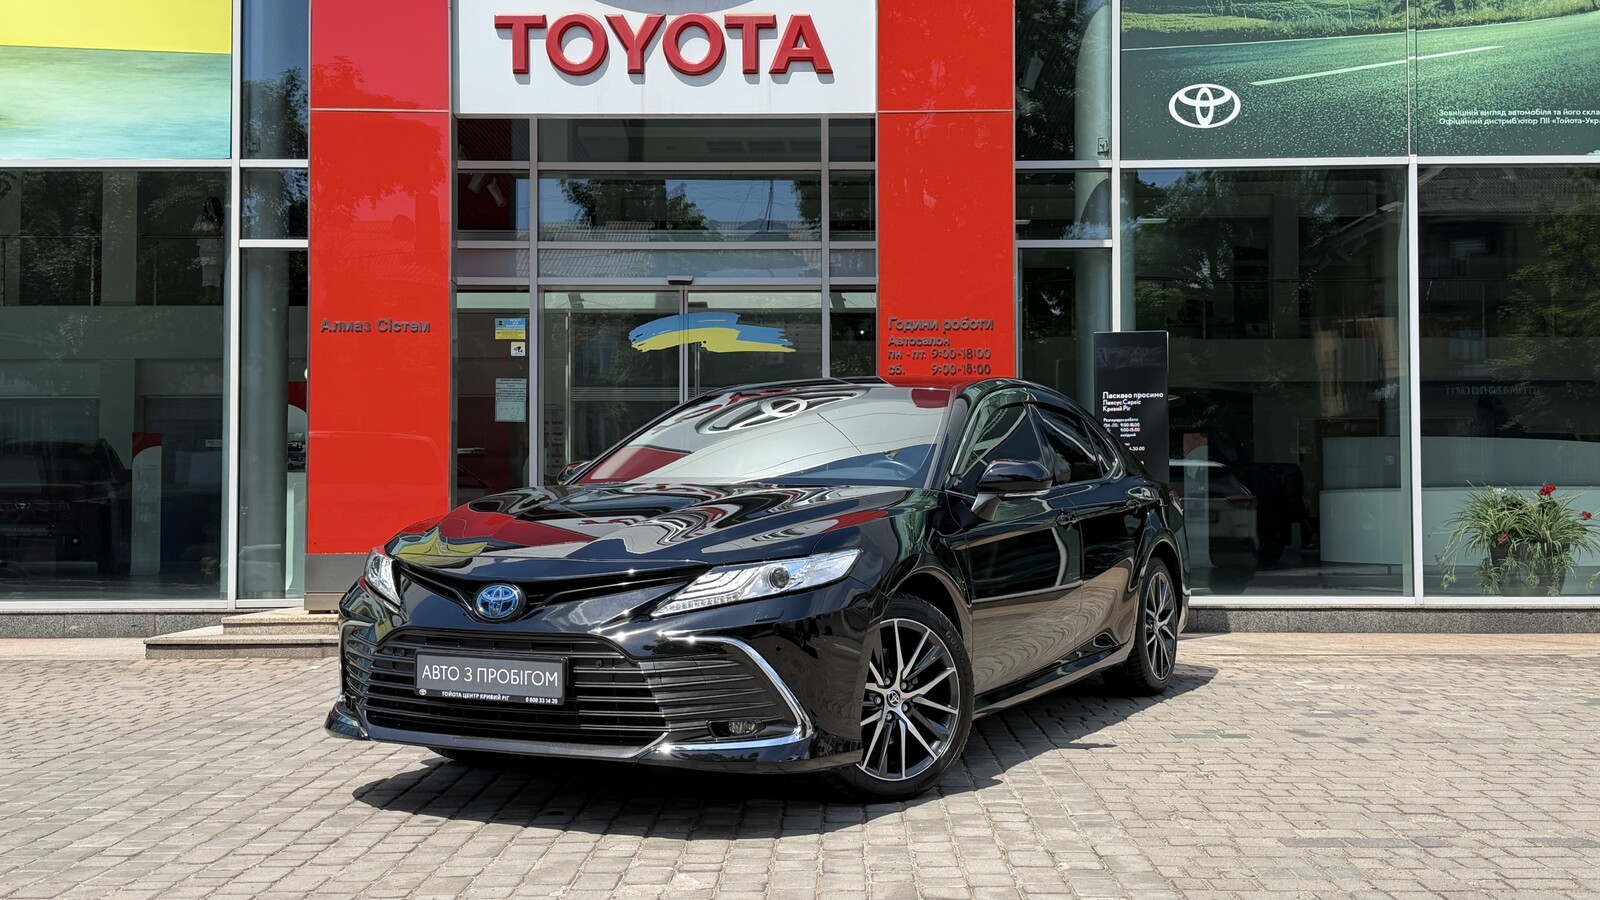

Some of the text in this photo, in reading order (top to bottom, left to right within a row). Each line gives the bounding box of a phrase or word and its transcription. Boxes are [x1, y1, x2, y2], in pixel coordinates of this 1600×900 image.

[495, 13, 834, 77] TOYOTA
[1438, 108, 1479, 116] Зовнішній
[1508, 108, 1552, 116] автомобіля
[1563, 108, 1582, 116] його
[1438, 117, 1483, 126] Офіційний
[320, 318, 431, 333] Алмаз Сістем
[888, 316, 994, 334] Години роботи
[888, 336, 951, 347] Автосалон
[888, 350, 903, 360] пн
[931, 348, 991, 360] 9:00-18:00
[888, 364, 906, 376] сб.
[1102, 391, 1133, 399] Ласкаво
[421, 664, 558, 687] АВТО З ПРОБІГОМ
[441, 690, 462, 698] ТОЙОТА
